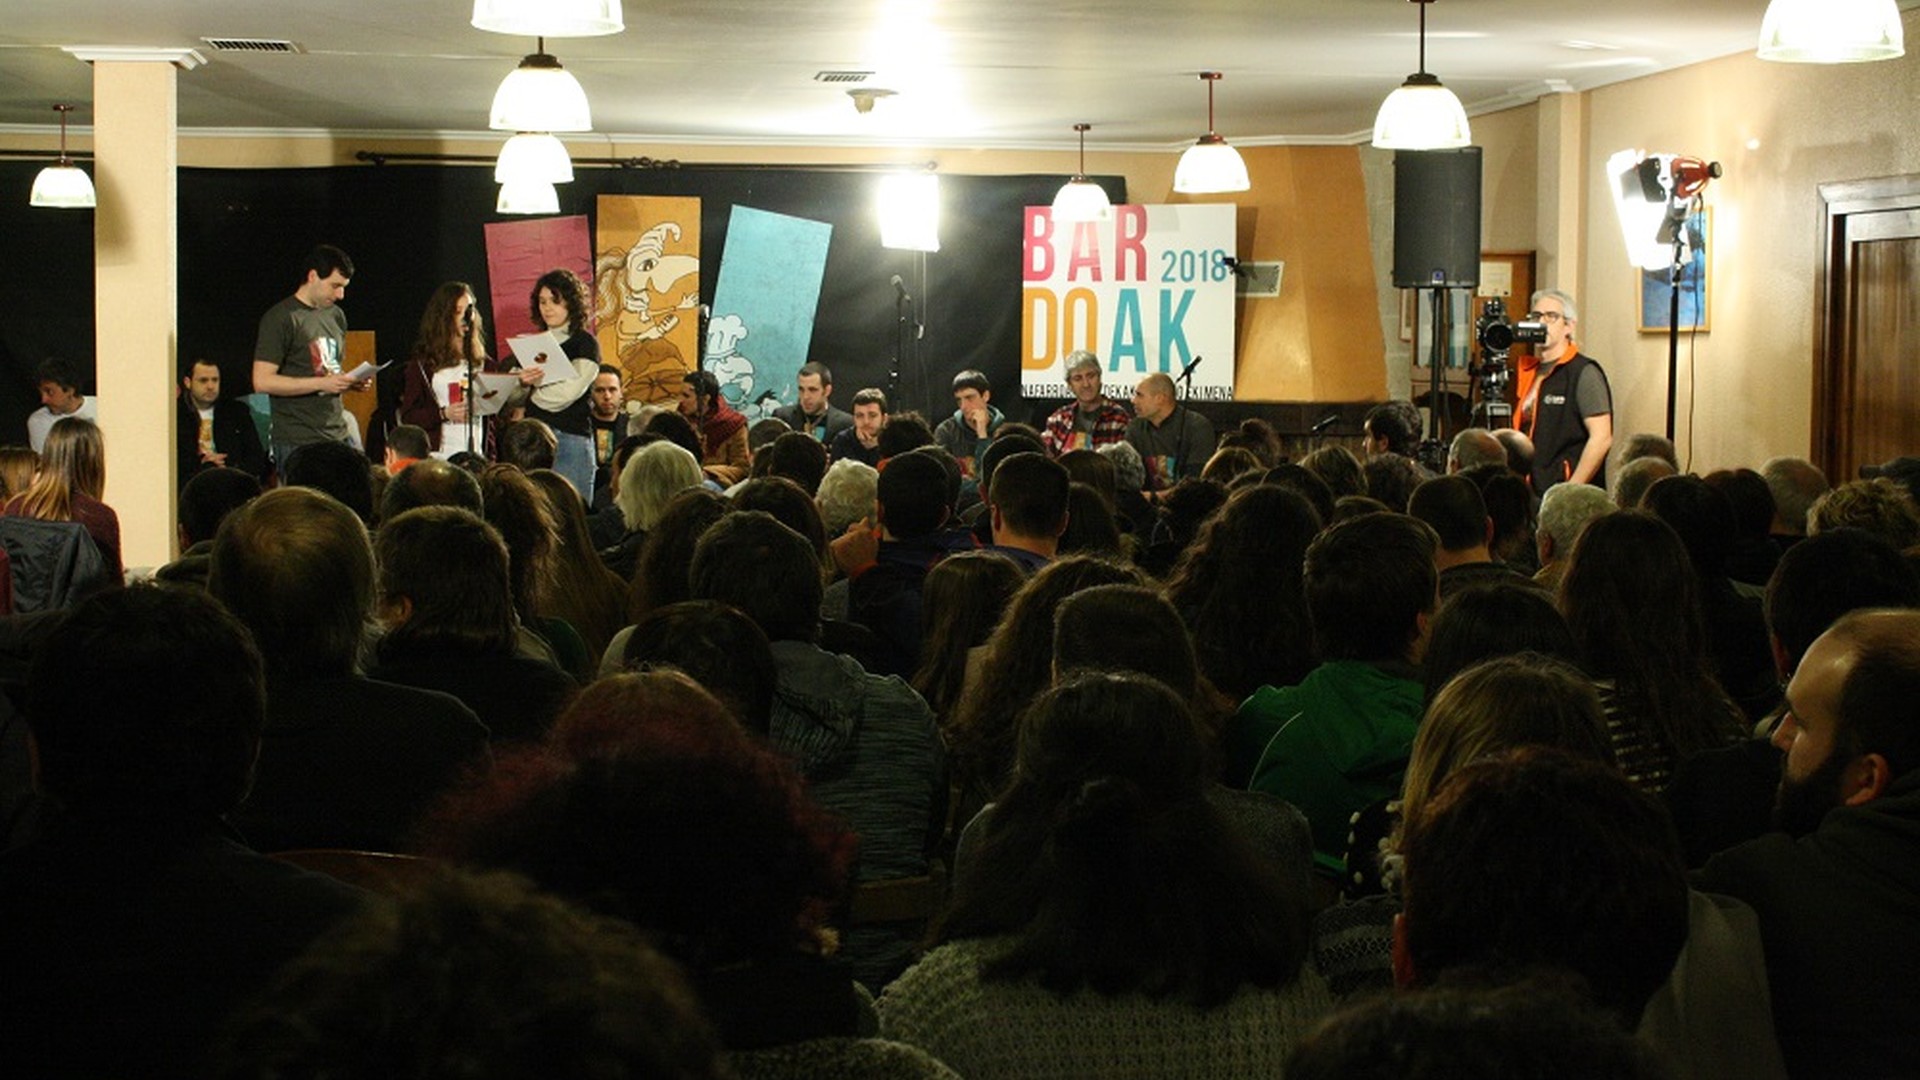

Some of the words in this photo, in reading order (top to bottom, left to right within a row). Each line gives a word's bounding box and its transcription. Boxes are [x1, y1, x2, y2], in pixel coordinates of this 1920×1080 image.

[1023, 204, 1147, 282] BAR
[1161, 249, 1227, 283] 2018
[1021, 384, 1076, 399] NAFARROA
